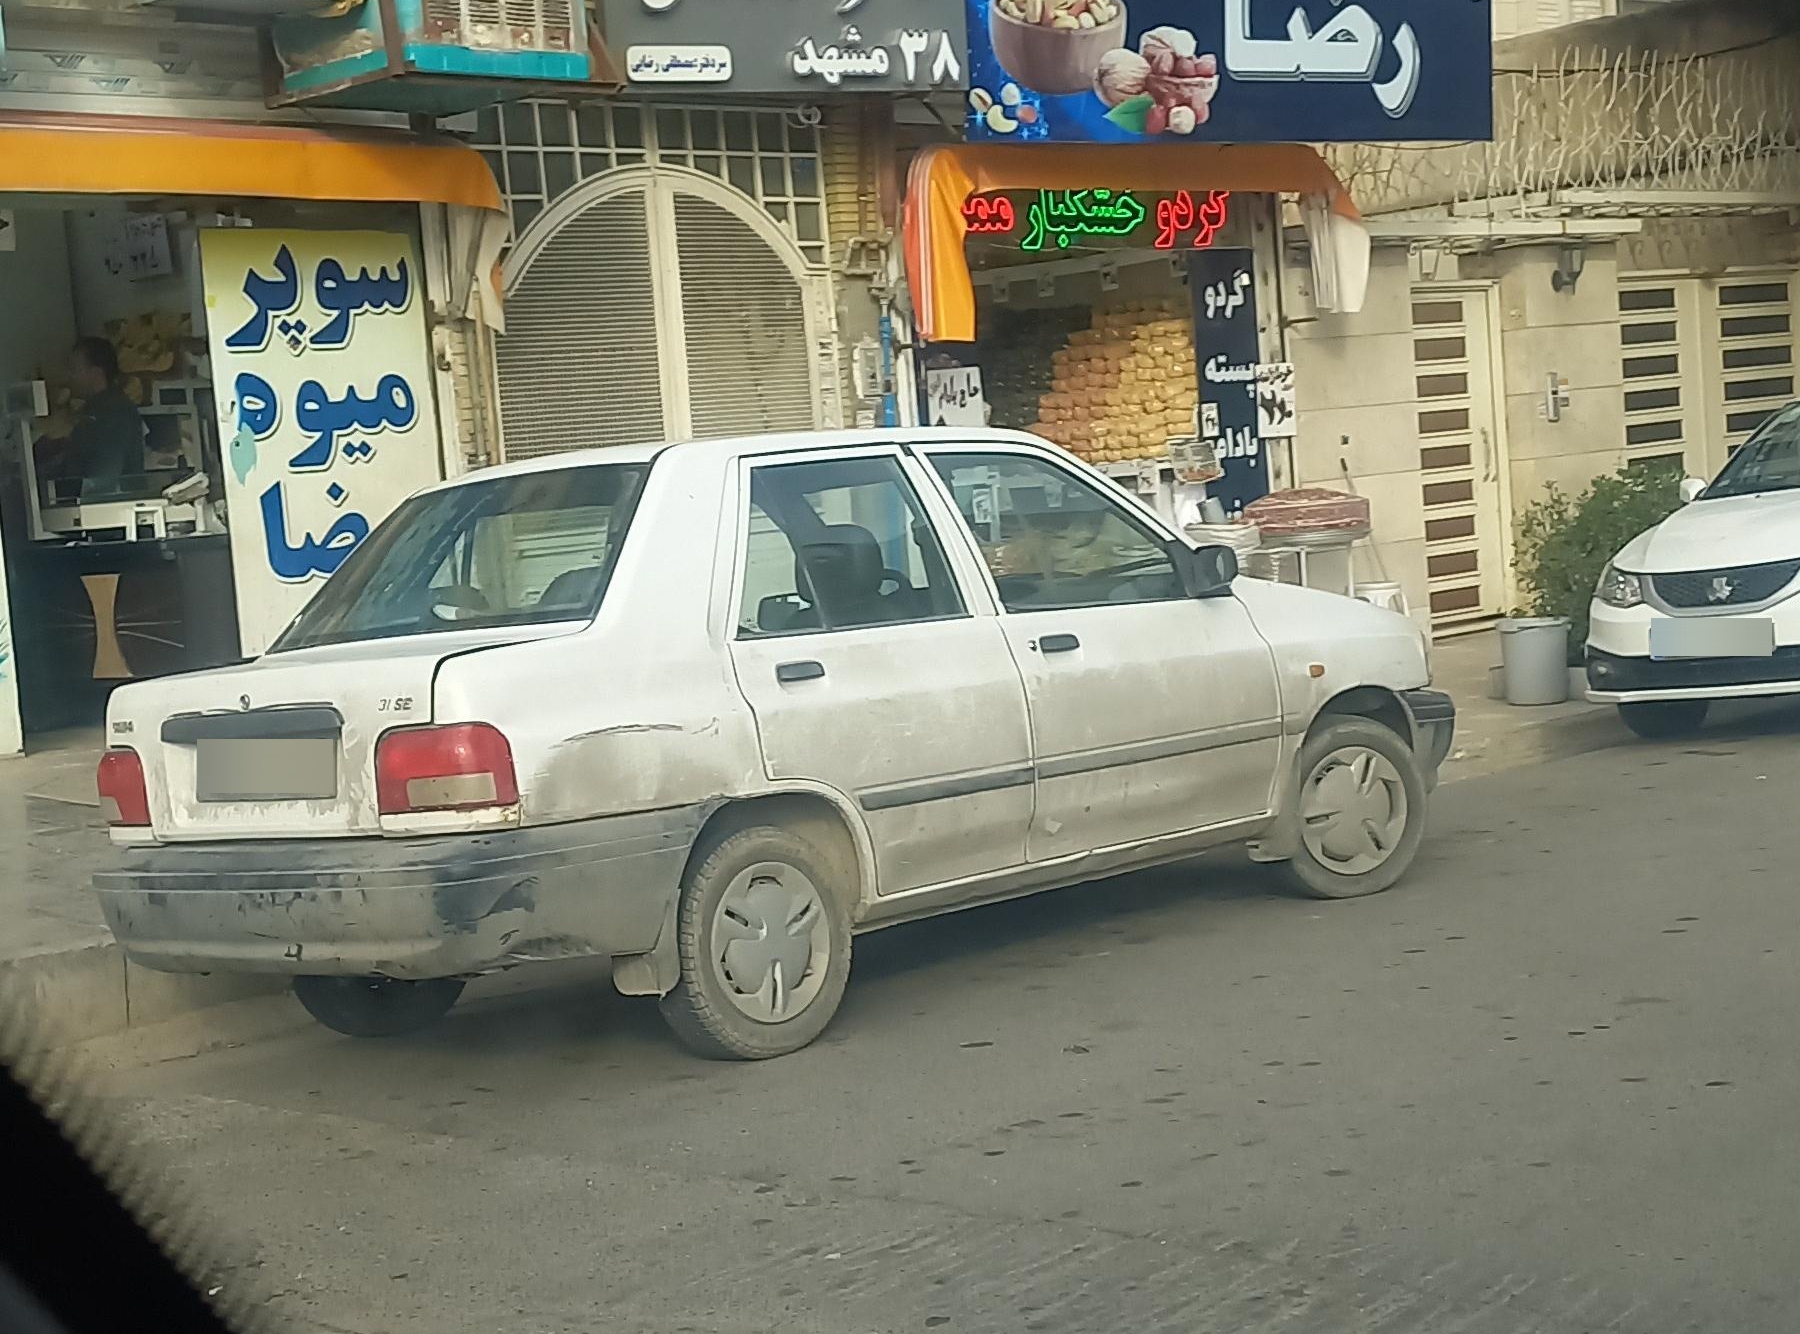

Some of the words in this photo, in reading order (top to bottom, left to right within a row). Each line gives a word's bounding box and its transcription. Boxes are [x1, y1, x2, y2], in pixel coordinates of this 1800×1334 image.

[791, 22, 890, 86] مشهد
[898, 27, 961, 84] ۳۸
[225, 243, 410, 352] سوپر
[1203, 268, 1248, 320] گردو
[235, 372, 416, 468] میوه
[259, 480, 371, 580] ضا
